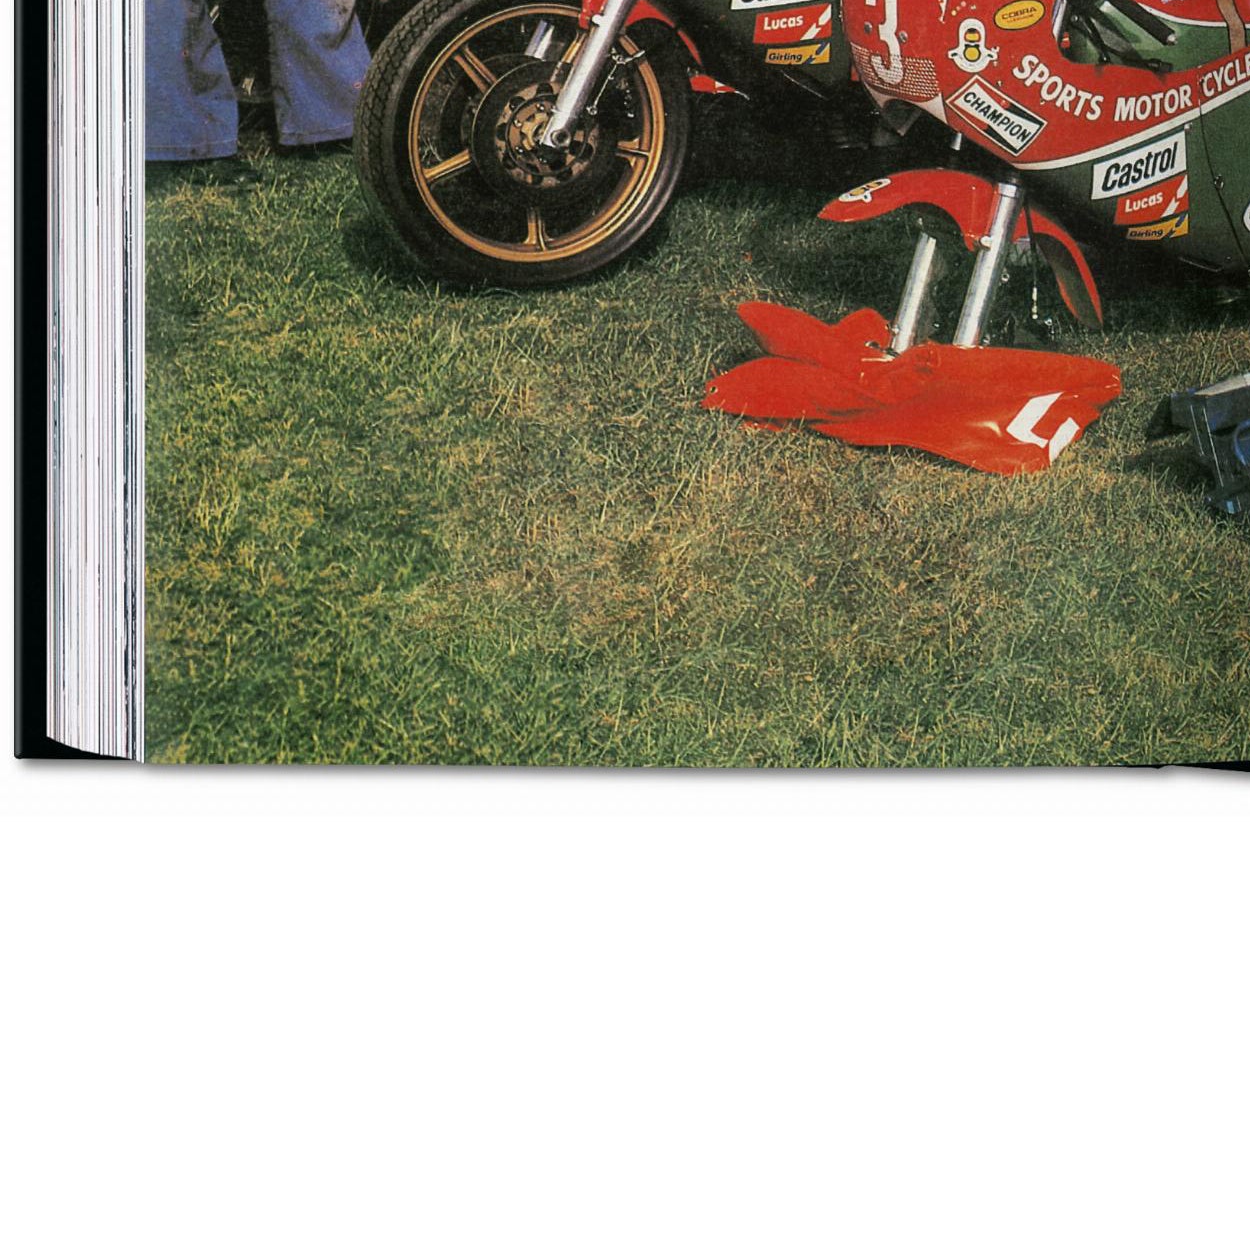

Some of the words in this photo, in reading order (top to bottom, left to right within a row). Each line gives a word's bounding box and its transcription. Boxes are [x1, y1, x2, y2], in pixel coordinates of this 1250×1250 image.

[763, 15, 804, 31] Lucas
[1001, 6, 1038, 21] COBRA
[768, 52, 803, 63] Girling
[1011, 53, 1104, 121] SPORTS
[1113, 84, 1193, 123] MOTOR
[962, 90, 1032, 143] CHAMPION
[1101, 141, 1178, 193] Castrol
[1124, 192, 1164, 214] Lucas
